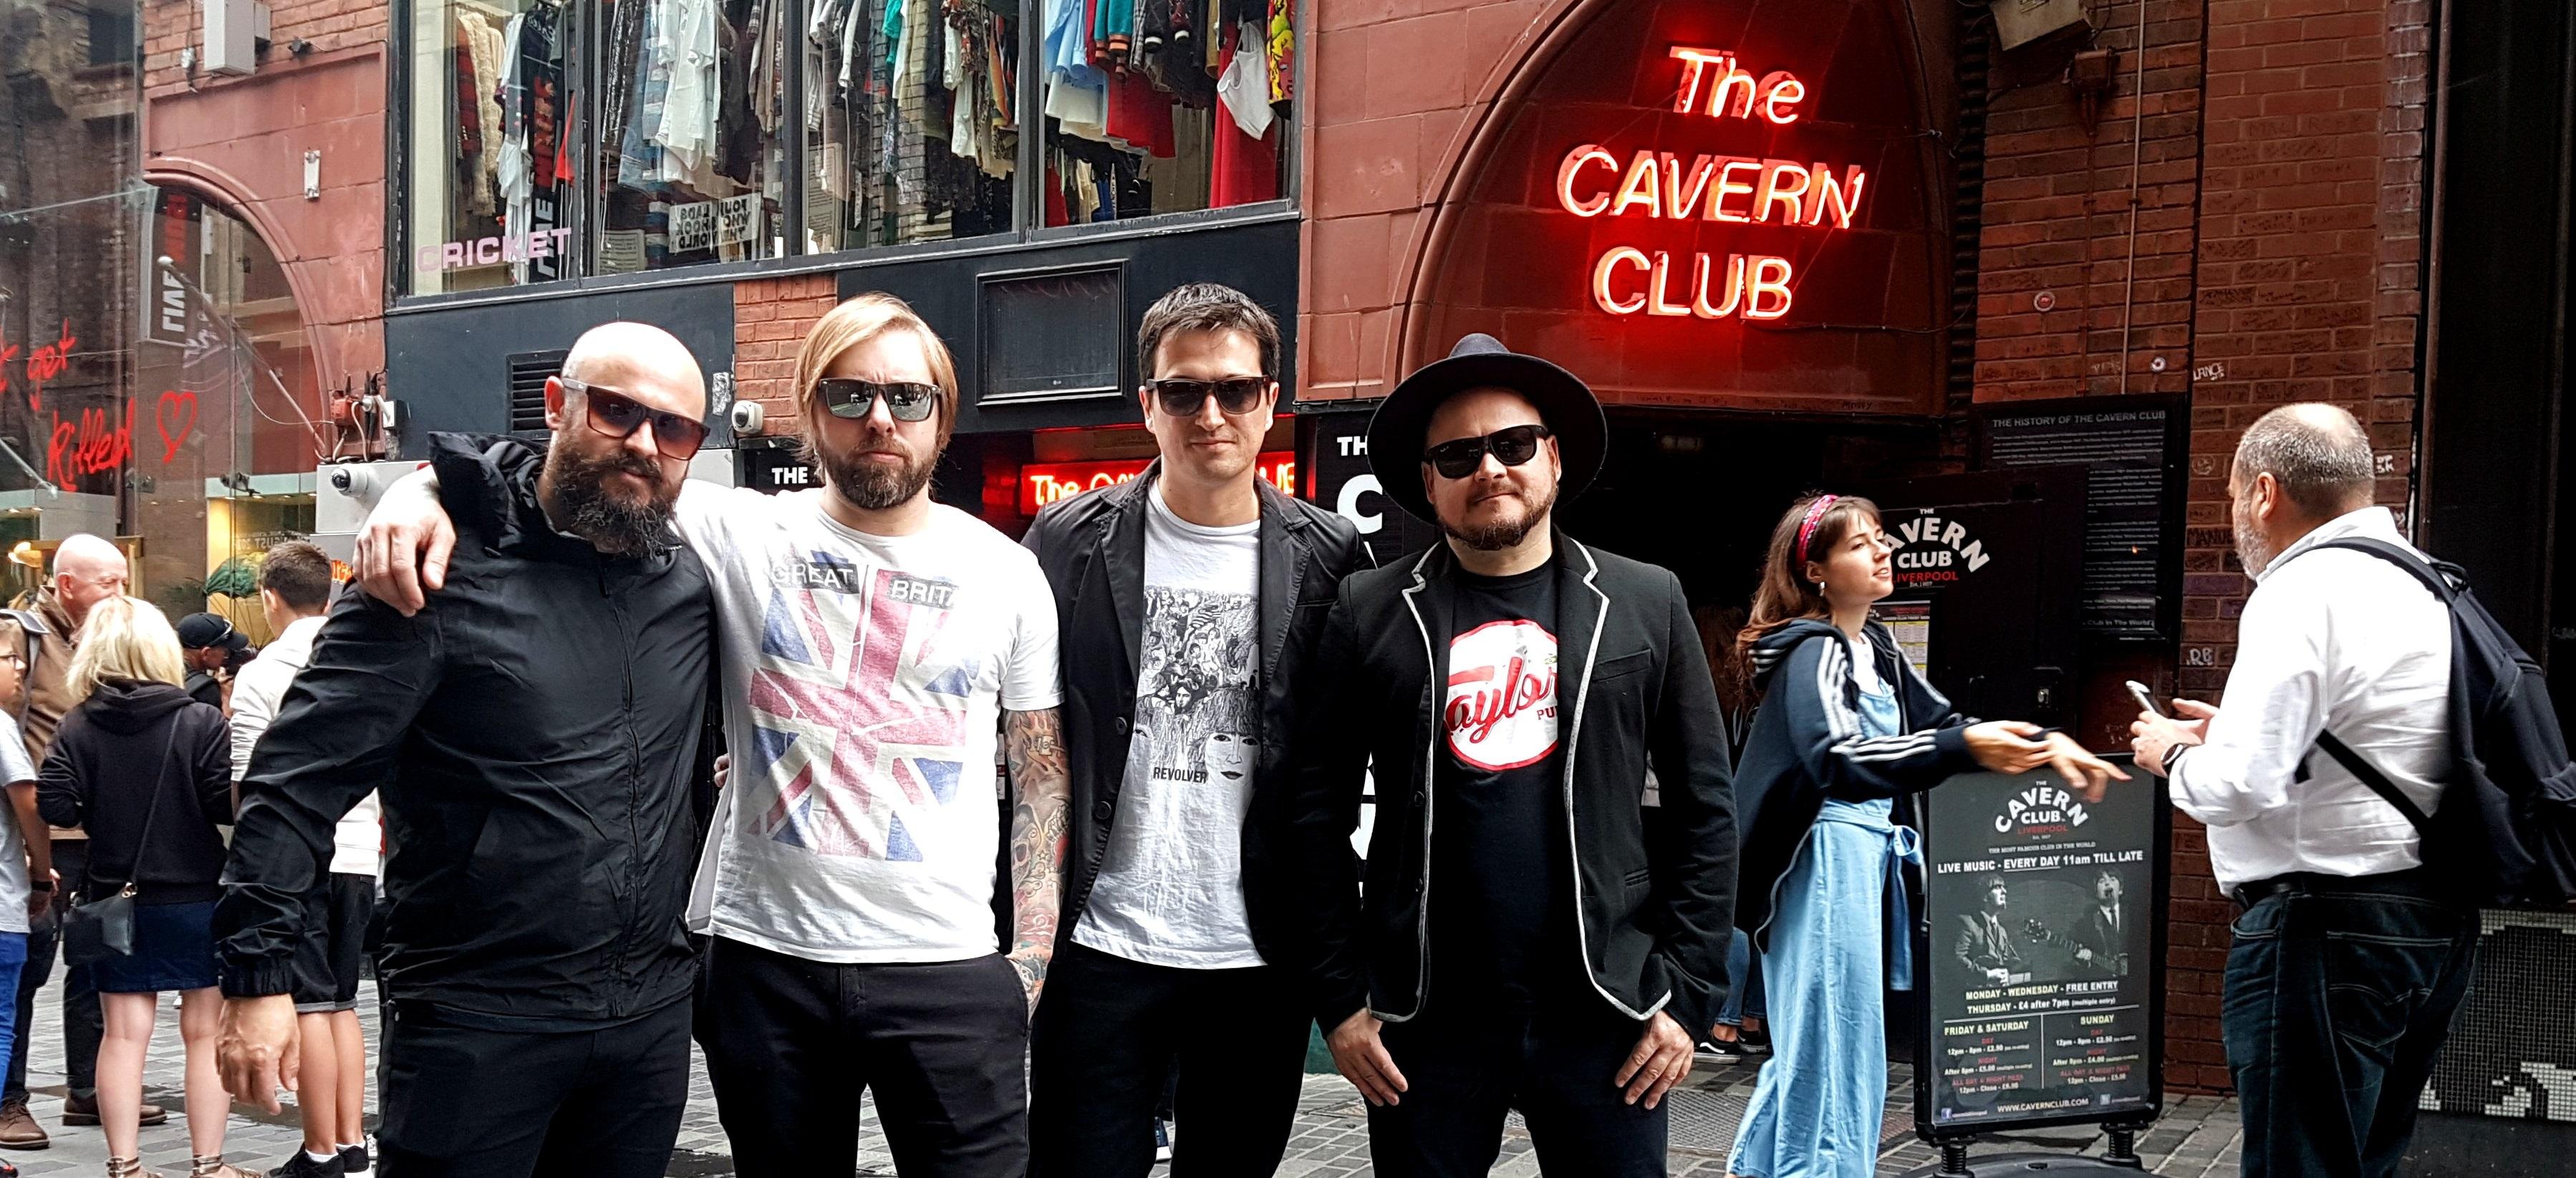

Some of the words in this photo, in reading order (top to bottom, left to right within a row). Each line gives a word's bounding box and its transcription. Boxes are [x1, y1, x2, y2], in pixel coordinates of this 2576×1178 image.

[1669, 46, 1805, 125] The
[1557, 143, 1865, 229] CAVERN
[417, 227, 571, 272] CRICKET
[1593, 246, 1793, 320] CLUB
[27, 317, 77, 412] get
[1993, 418, 2012, 428] THE
[2014, 416, 2056, 427] HISTORY
[2058, 415, 2071, 425] OF
[2075, 414, 2093, 423] THE
[2095, 412, 2136, 423] CAVERN
[2138, 410, 2166, 420] CLUB
[1337, 435, 1368, 456] TH
[772, 467, 808, 485] THE
[1884, 517, 1990, 573] AVERN
[1897, 551, 1952, 569] CLUB
[773, 563, 854, 589] GREAT
[1153, 766, 1208, 784] REVOLVER
[1995, 787, 2089, 833] CAVERN
[2021, 810, 2061, 824] CLUB
[2017, 825, 2068, 835] LIVERPOOL
[1938, 862, 1961, 874] LIVE
[1964, 861, 1995, 872] MUSIC
[2004, 857, 2037, 870] EVERY
[2040, 856, 2060, 867] DAY
[2063, 854, 2090, 865] 11am
[2093, 853, 2116, 864] TILL
[2118, 851, 2143, 861] LATE
[1966, 990, 2001, 1000] MONDAY
[2008, 985, 2058, 997] WEDNESDAY
[2066, 982, 2088, 993] FREE
[2090, 980, 2118, 991] ENTRY
[1967, 1003, 2011, 1014] THURSDAY
[2031, 1000, 2050, 1010] after
[2052, 998, 2070, 1009] 7pm
[1944, 1025, 1975, 1035] FRIDAY
[1986, 1021, 2029, 1033] SATURDAY
[2080, 1014, 2115, 1025] SUNDAY
[1997, 1098, 2089, 1113] WWW.CAVERNCLUB.COM
